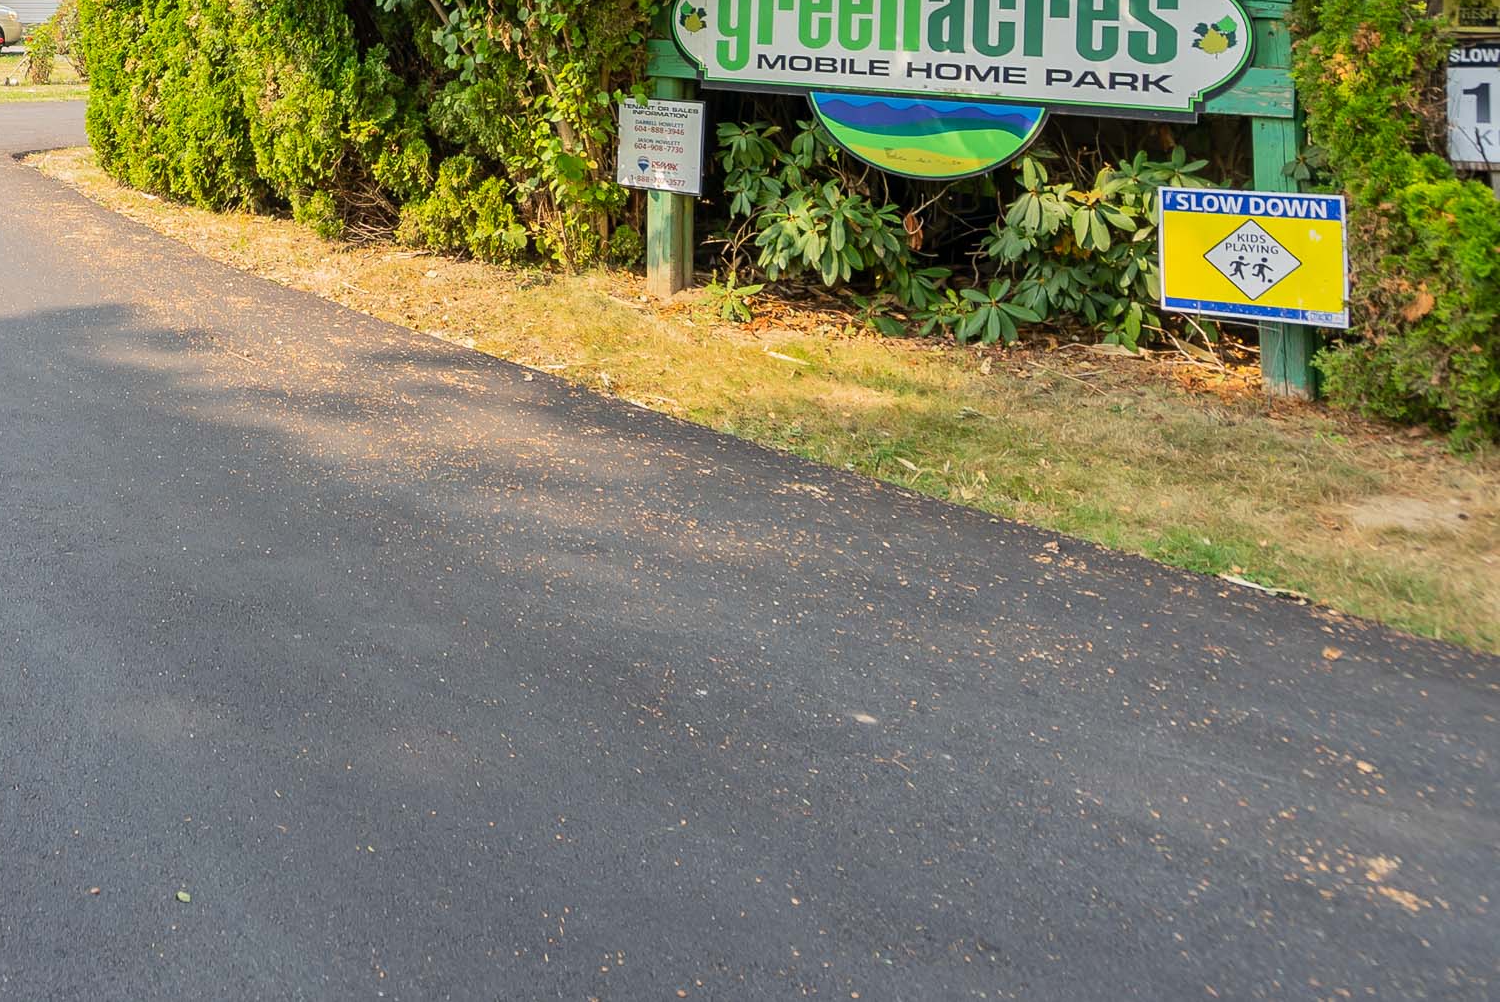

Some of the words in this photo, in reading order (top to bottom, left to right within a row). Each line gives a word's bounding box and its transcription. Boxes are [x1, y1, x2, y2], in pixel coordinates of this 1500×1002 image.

[1449, 48, 1500, 63] SLOW
[757, 53, 890, 77] MOBILE
[906, 61, 1027, 85] HOME
[1045, 68, 1173, 94] PARK
[623, 103, 655, 111] TENANT
[632, 109, 688, 119] INFORMATION
[1176, 193, 1243, 214] SLOW
[1249, 196, 1328, 219] DOWN
[1236, 233, 1267, 244] KIDS
[1225, 242, 1279, 255] PLAYING
